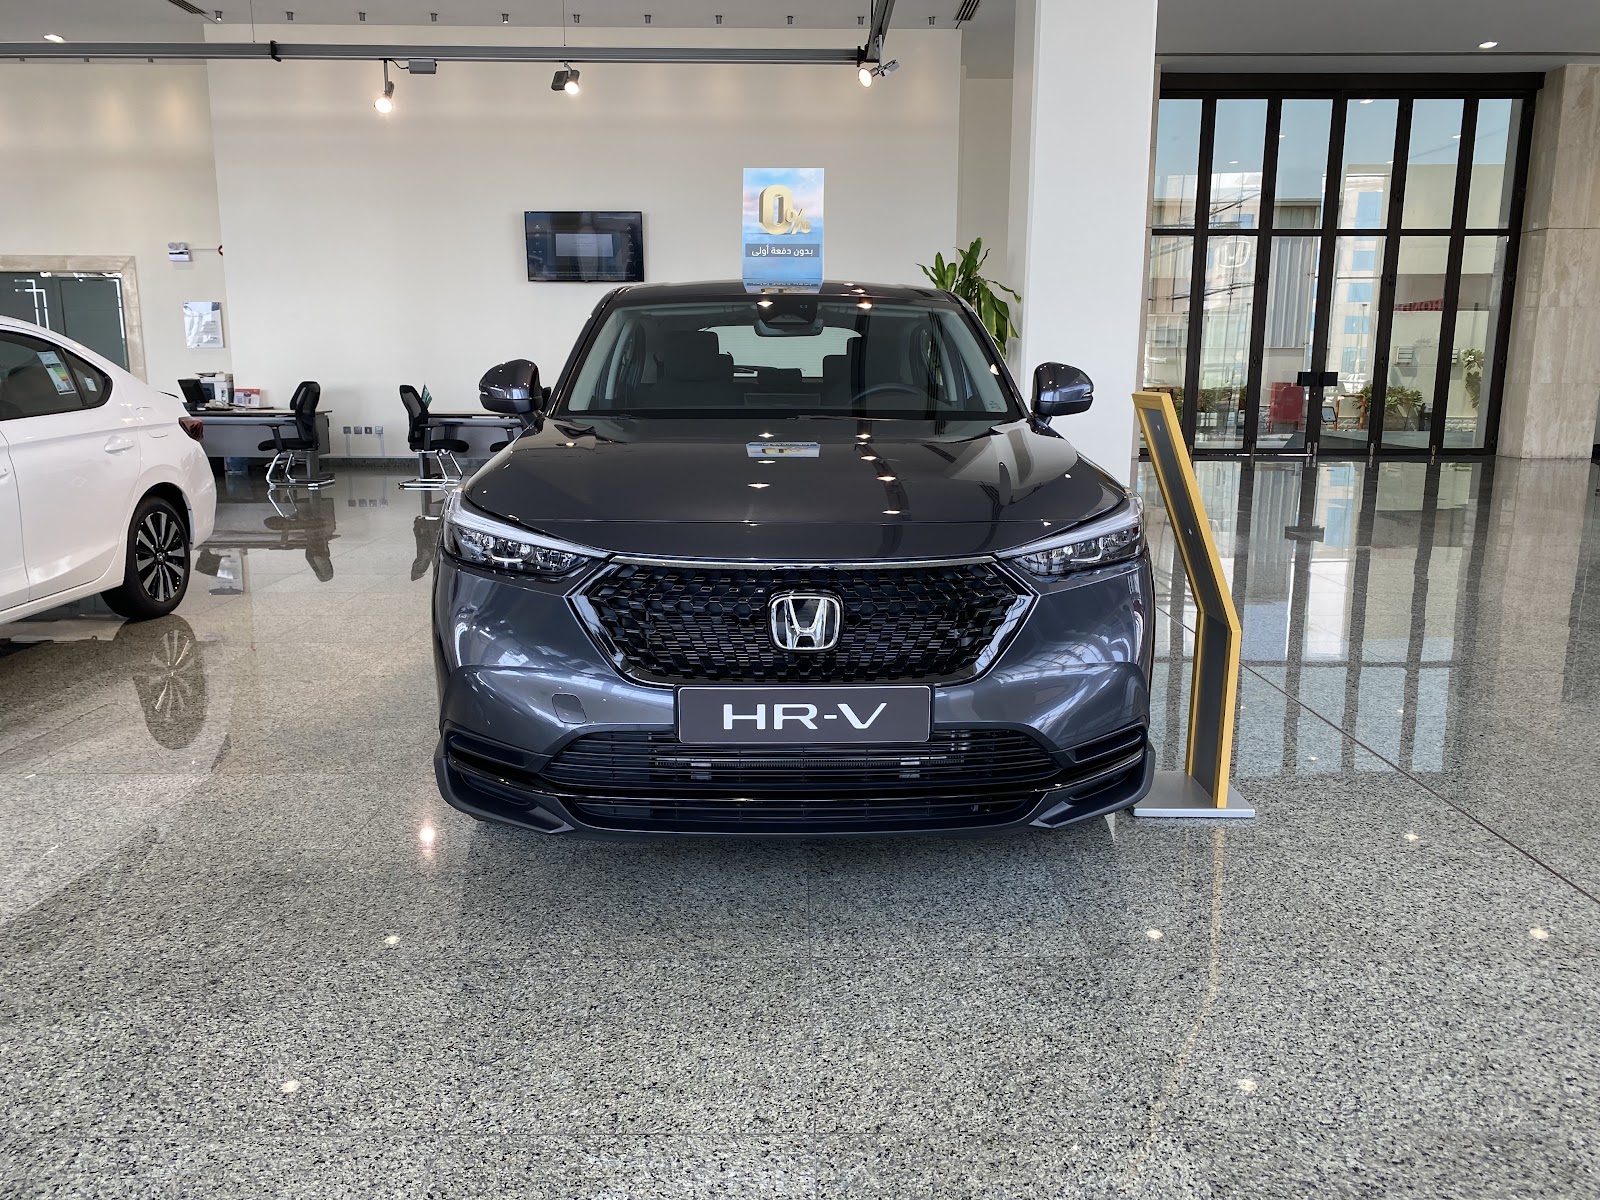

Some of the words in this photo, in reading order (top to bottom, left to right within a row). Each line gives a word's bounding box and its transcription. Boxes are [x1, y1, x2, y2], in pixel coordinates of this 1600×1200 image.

[759, 184, 812, 235] 0%
[751, 244, 769, 257] أولى
[770, 246, 792, 255] دفعة
[793, 248, 814, 257] بدون
[722, 702, 888, 730] HR-V
